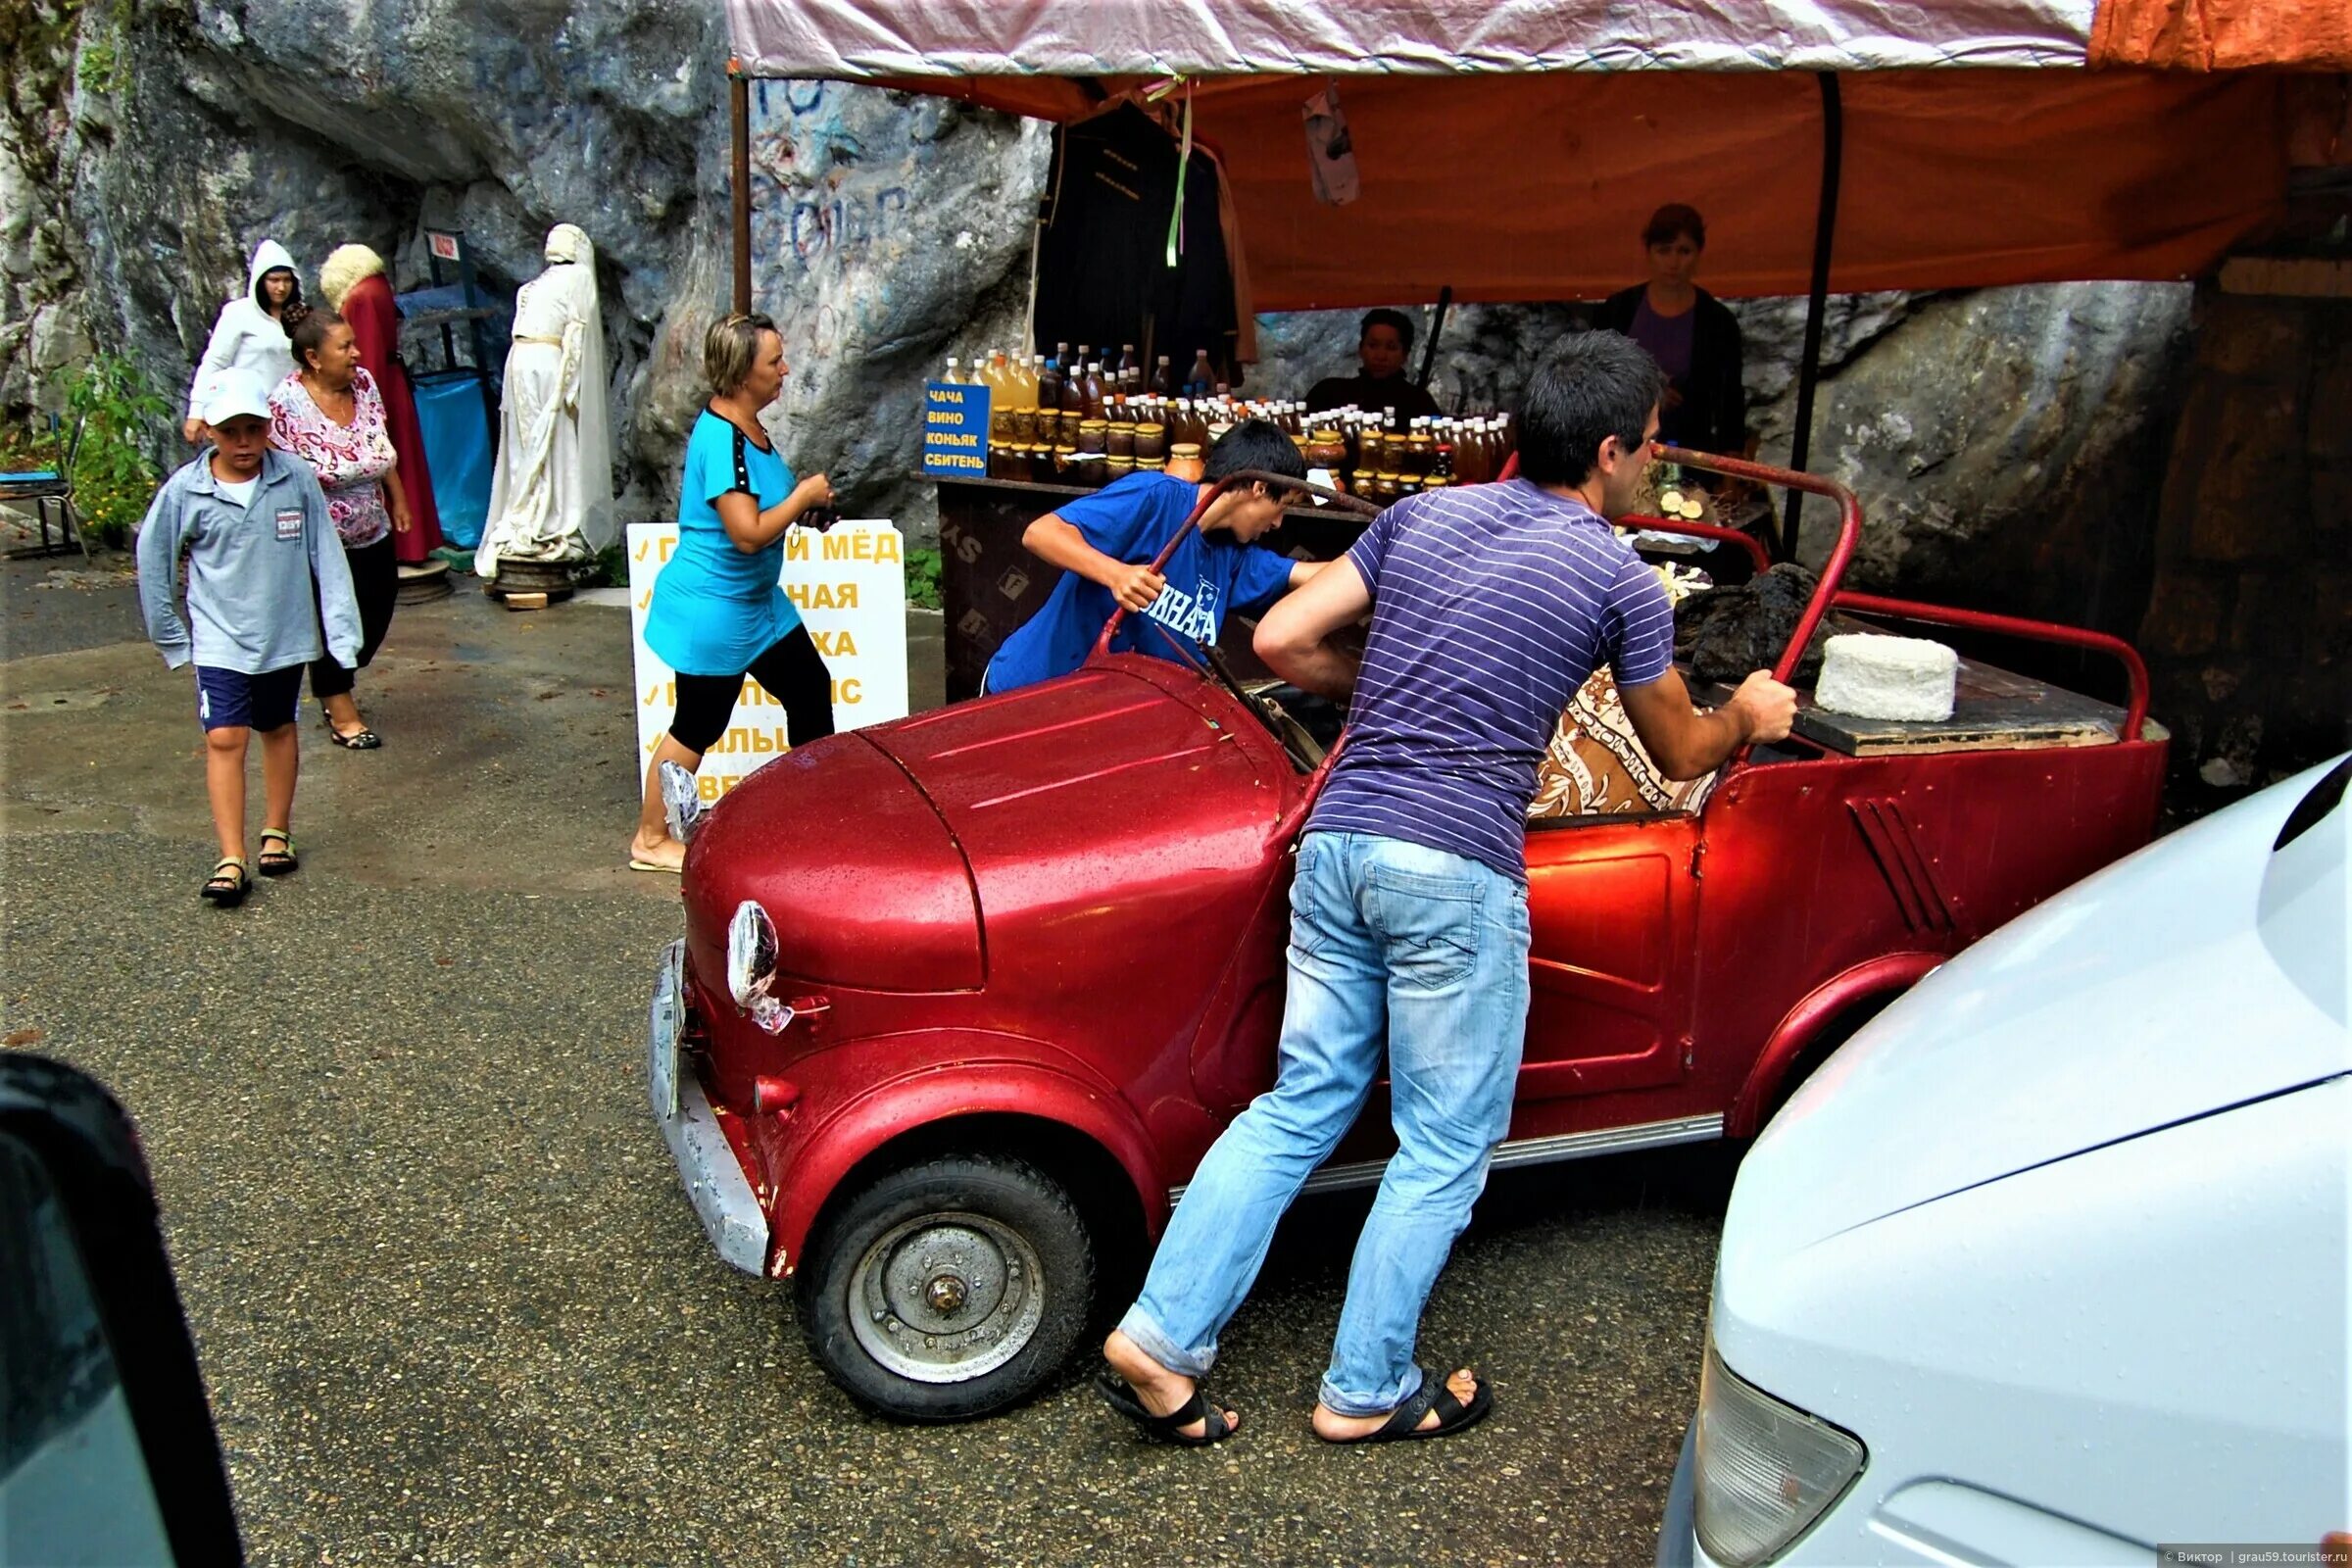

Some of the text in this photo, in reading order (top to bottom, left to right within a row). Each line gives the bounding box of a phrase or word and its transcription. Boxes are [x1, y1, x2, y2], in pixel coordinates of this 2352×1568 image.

[929, 389, 963, 404] ЧАЧА
[927, 411, 964, 425] ВИНО
[926, 432, 978, 447] КОНЬЯК
[924, 453, 985, 468] СБИТЕНЬ
[823, 528, 900, 564] МЁД
